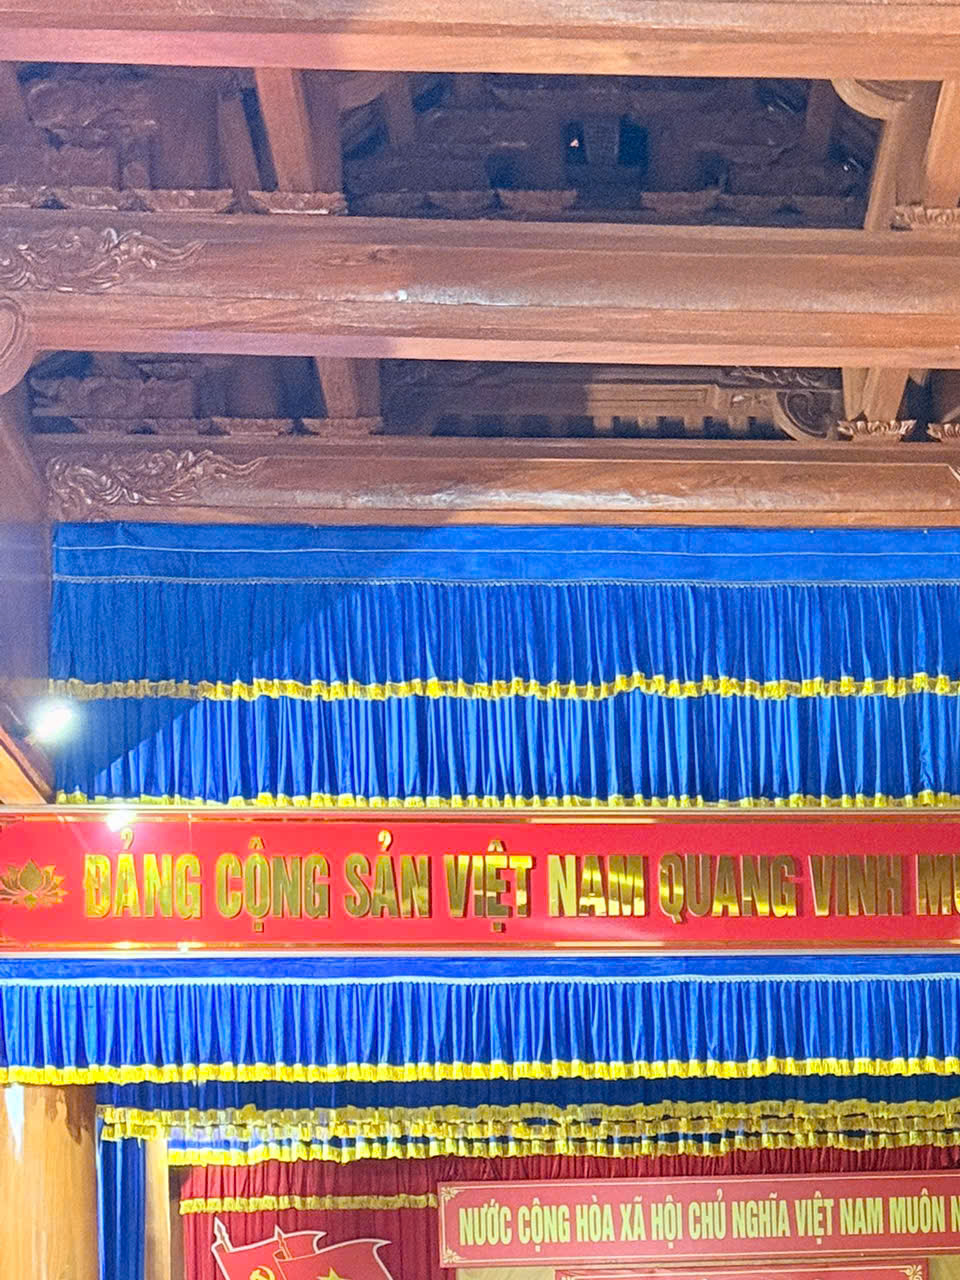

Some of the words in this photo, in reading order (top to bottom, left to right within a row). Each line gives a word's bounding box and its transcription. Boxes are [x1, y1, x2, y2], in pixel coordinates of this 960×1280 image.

[84, 830, 201, 918] ĐẢNG
[216, 836, 330, 932] CỘNG
[344, 830, 431, 918] SẢN
[444, 840, 532, 932] VIỆT
[548, 854, 649, 917] NAM
[658, 854, 797, 924] QUANG
[808, 854, 902, 916] VINH
[459, 1198, 512, 1246] NƯỚC
[518, 1197, 571, 1252] CỘNG
[576, 1195, 615, 1242] HÒA
[620, 1196, 647, 1242] XÃ
[651, 1195, 683, 1249] HỘI
[688, 1188, 726, 1239] CHỦ
[731, 1192, 791, 1239] NGHĨA
[794, 1190, 834, 1245] VIỆT
[840, 1197, 884, 1236] NAM
[889, 1188, 946, 1234] MUÔN
